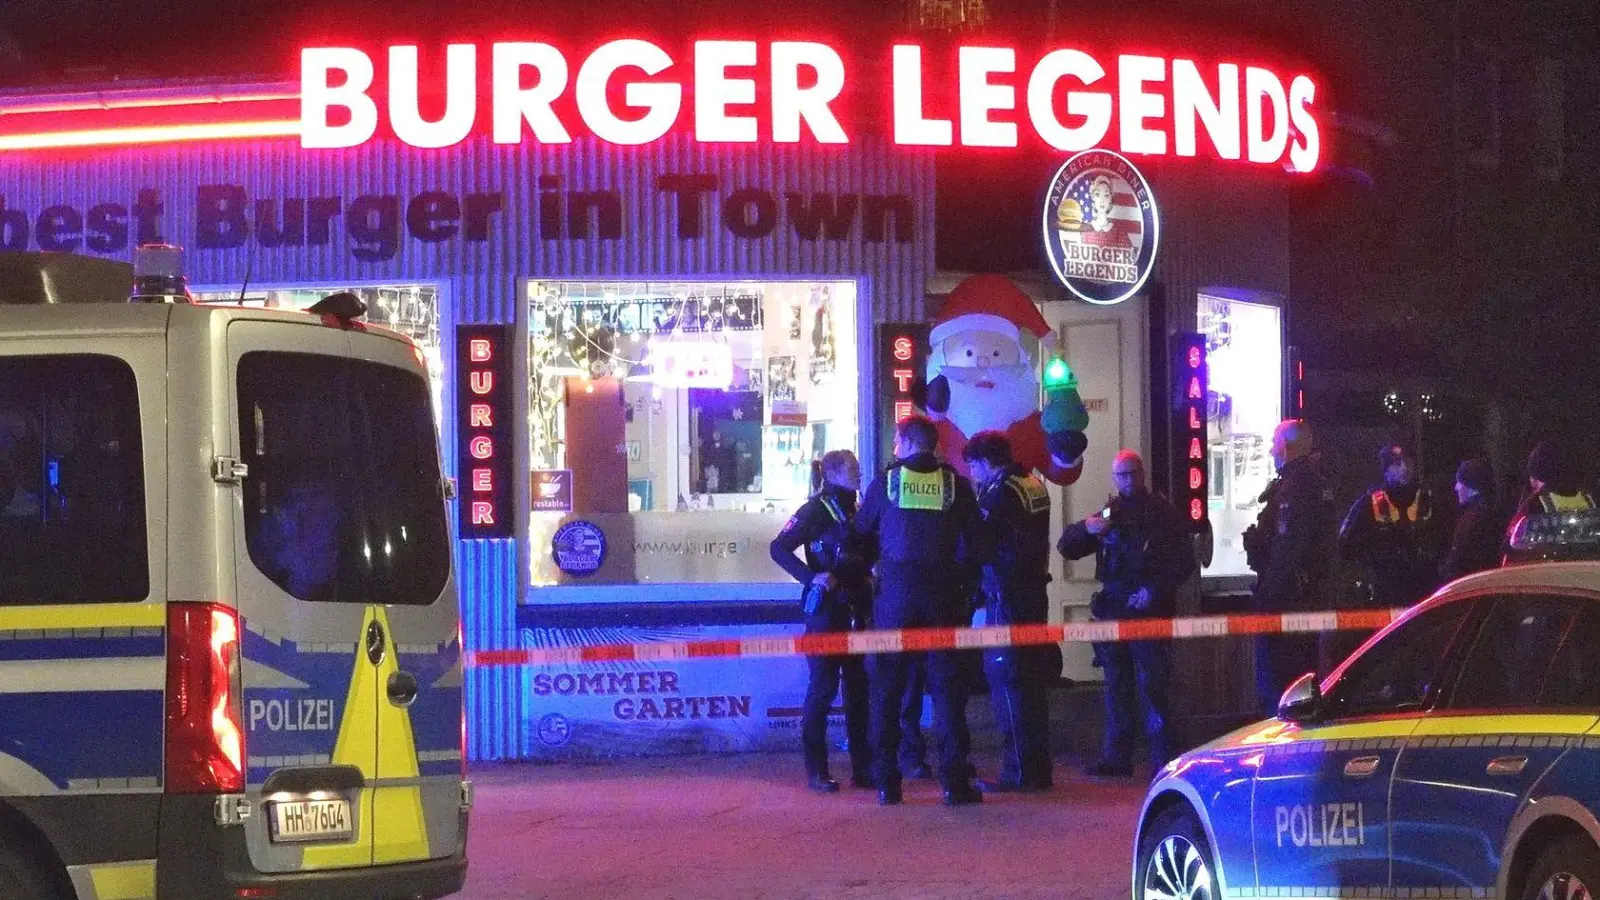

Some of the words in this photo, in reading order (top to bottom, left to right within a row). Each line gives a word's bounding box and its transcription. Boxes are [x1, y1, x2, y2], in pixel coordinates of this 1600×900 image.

[301, 39, 848, 148] BURGER
[893, 45, 1320, 172] LEGENDS
[1051, 155, 1111, 206] AMERICAN
[1118, 162, 1150, 211] DINER
[197, 184, 501, 262] Burger
[538, 174, 623, 241] in
[656, 173, 916, 242] Town
[1065, 261, 1137, 282] LEGENDS
[1070, 243, 1133, 264] BURGER
[893, 337, 913, 426] STE
[470, 339, 494, 525] BURGER
[1189, 346, 1203, 520] SALADS
[903, 481, 941, 496] POLIZEI
[533, 671, 679, 697] SOMMER
[250, 699, 334, 732] POLIZEI
[613, 696, 752, 721] GARTEN
[285, 805, 304, 832] HH
[311, 804, 343, 830] 7604
[1276, 802, 1365, 847] POLIZEI
